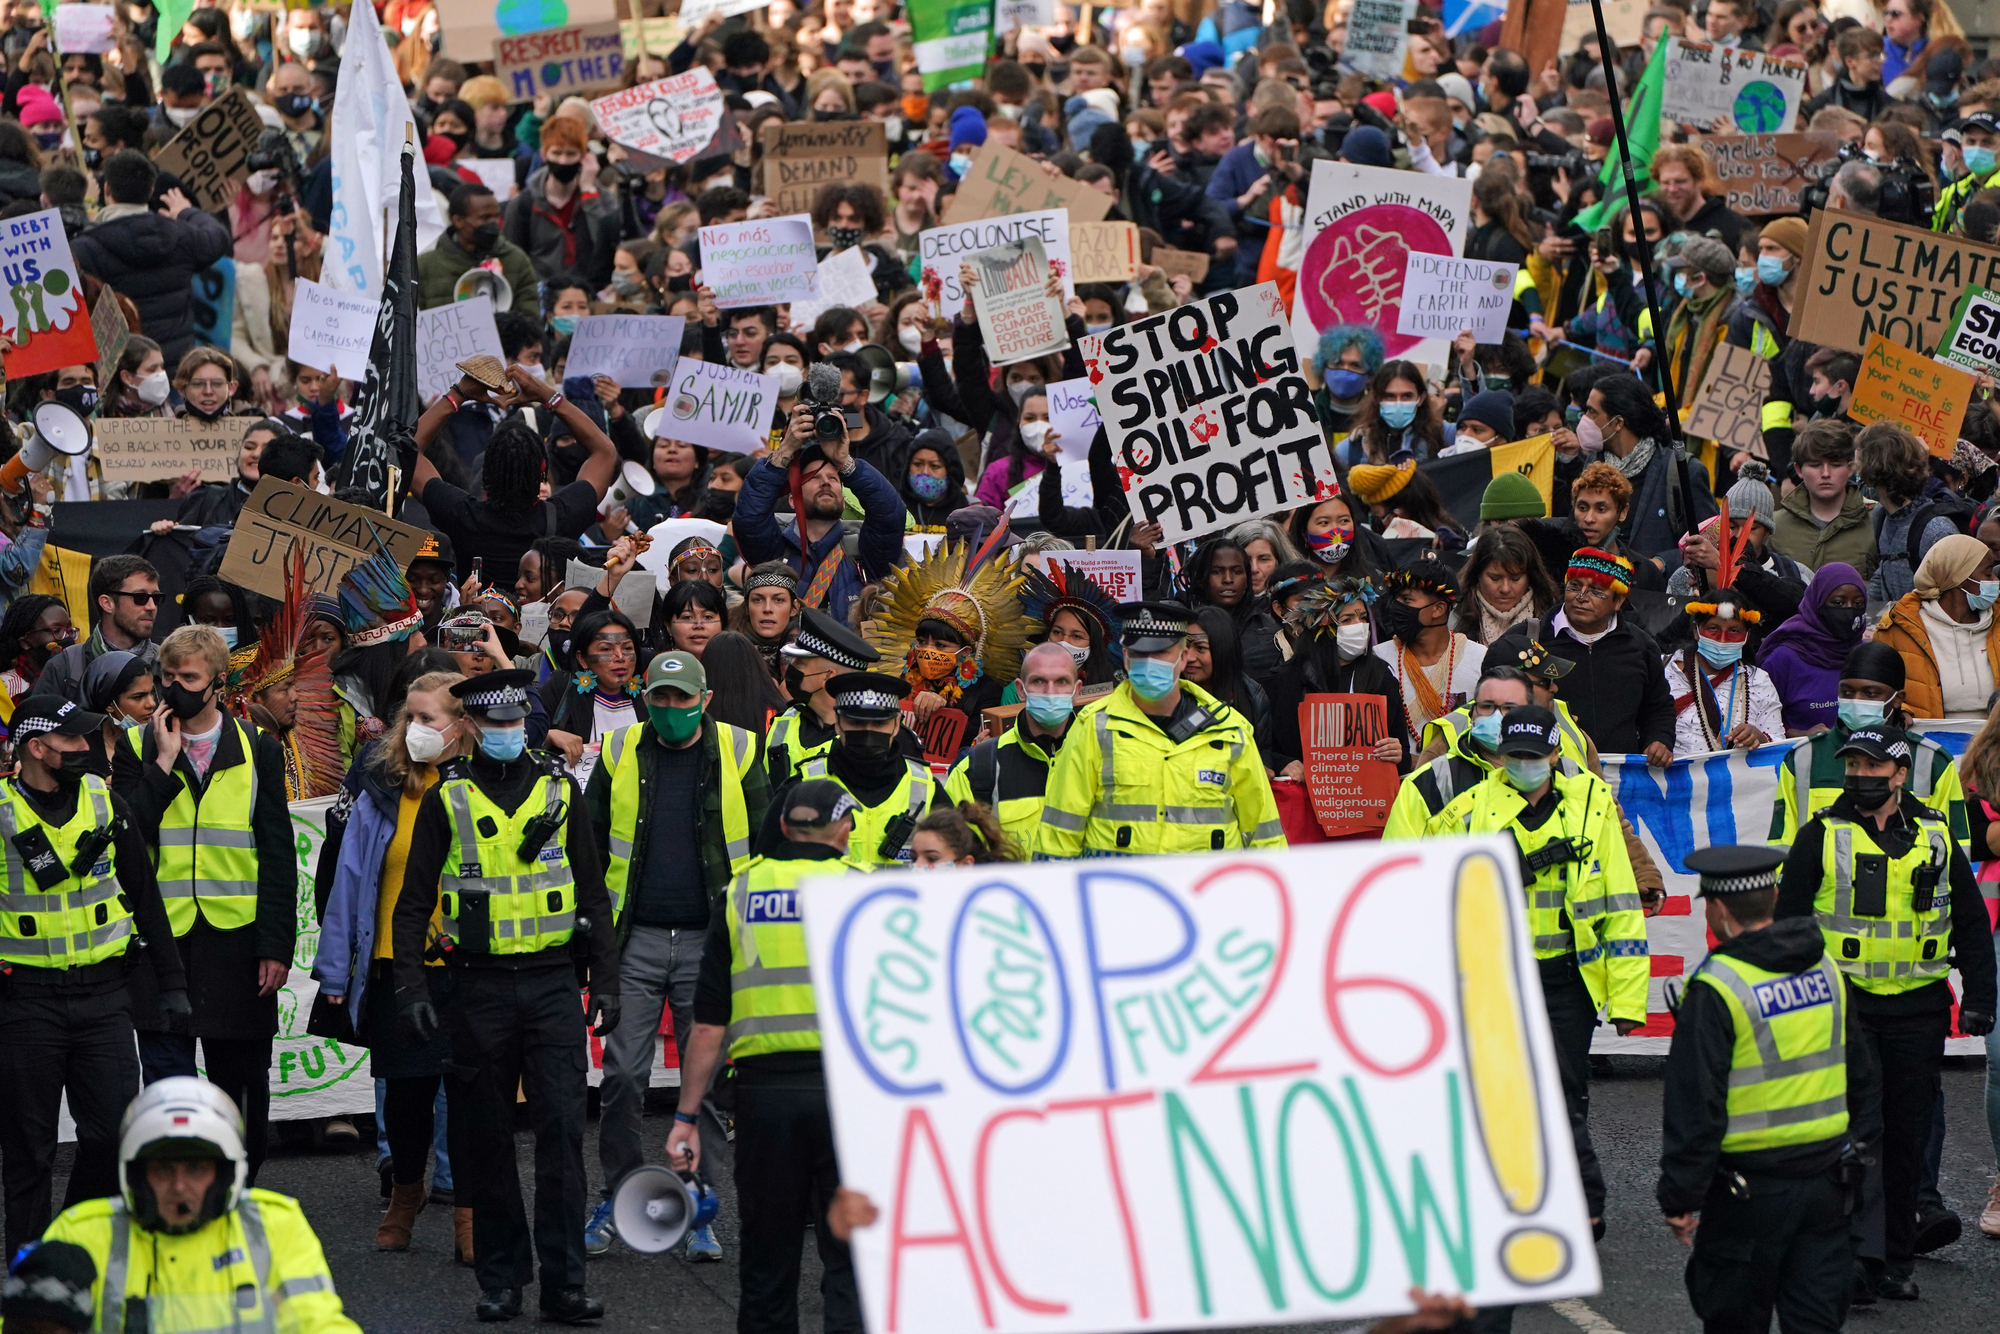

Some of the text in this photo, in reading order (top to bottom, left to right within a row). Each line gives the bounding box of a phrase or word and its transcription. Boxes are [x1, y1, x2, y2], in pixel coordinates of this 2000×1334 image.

[500, 28, 582, 66] RESPECT
[1679, 41, 1714, 64] THERE
[195, 106, 248, 178] OUT
[174, 127, 226, 205] PEOPLE
[985, 154, 1035, 198] LEY
[1313, 191, 1456, 233] STAND WITH MAPA
[10, 216, 50, 238] DEBT
[701, 226, 772, 247] No más
[923, 217, 1057, 260] DECOLONISE
[4, 236, 52, 258] WITH
[709, 242, 814, 265] negociaciones
[1825, 221, 2000, 290] CLIMATE
[2, 258, 42, 287] US
[718, 260, 796, 280] sin escuchar
[1073, 253, 1123, 279] HORA
[709, 279, 765, 298] nuestras
[1436, 279, 1470, 295] THE
[305, 287, 378, 318] No es monocult
[990, 301, 1046, 325] FOR OUR
[1417, 293, 1504, 311] EARTH AND
[325, 316, 340, 329] es
[416, 306, 471, 340] MATE
[575, 318, 670, 342] NO MORE
[992, 310, 1053, 335] CLIMATE,
[996, 321, 1051, 344] FOR OUR
[1103, 292, 1240, 375] STOP
[417, 328, 486, 367] UGGLE
[998, 330, 1055, 355] FUTURE
[425, 363, 439, 376] IS
[1867, 342, 1925, 379] Act as
[695, 360, 762, 389] JUSTICIA
[1111, 324, 1300, 430] SPILLING
[672, 374, 763, 430] SAMIR
[1898, 379, 1931, 403] house
[1941, 397, 1954, 413] is
[1880, 390, 1951, 431] on FIRE
[163, 417, 193, 433] THE
[198, 418, 254, 433] SYSTEM
[1121, 376, 1320, 476] OIL FOR
[103, 441, 121, 454] GO
[127, 440, 162, 453] BACK
[163, 439, 182, 452] TO
[189, 438, 227, 452] YOUR
[1918, 426, 1946, 450] it is
[105, 456, 147, 469] ESCAZÚ
[150, 458, 188, 469] AHORA
[191, 457, 226, 471] FUERA
[1017, 486, 1040, 511] STO
[1138, 434, 1322, 542] PROFIT
[262, 489, 411, 555] CLIMATE
[1047, 572, 1137, 585] SALIST
[1073, 650, 1086, 660] DAS
[1087, 685, 1111, 695] CLOCK
[1507, 722, 1544, 736] POLICE
[1849, 730, 1884, 743] POLICE
[1310, 751, 1381, 761] There is n
[1310, 762, 1360, 773] climate
[1199, 770, 1226, 785] POLICE
[1310, 774, 1353, 784] future
[1312, 785, 1363, 796] without
[1318, 808, 1364, 821] peoples
[540, 848, 563, 860] POLICE
[866, 905, 937, 1071] STOP
[1755, 971, 1832, 1013] POLICE
[1115, 927, 1275, 1075] FUELS
[278, 1037, 347, 1085] FUT
[886, 1069, 1475, 1333] ACT NOW
